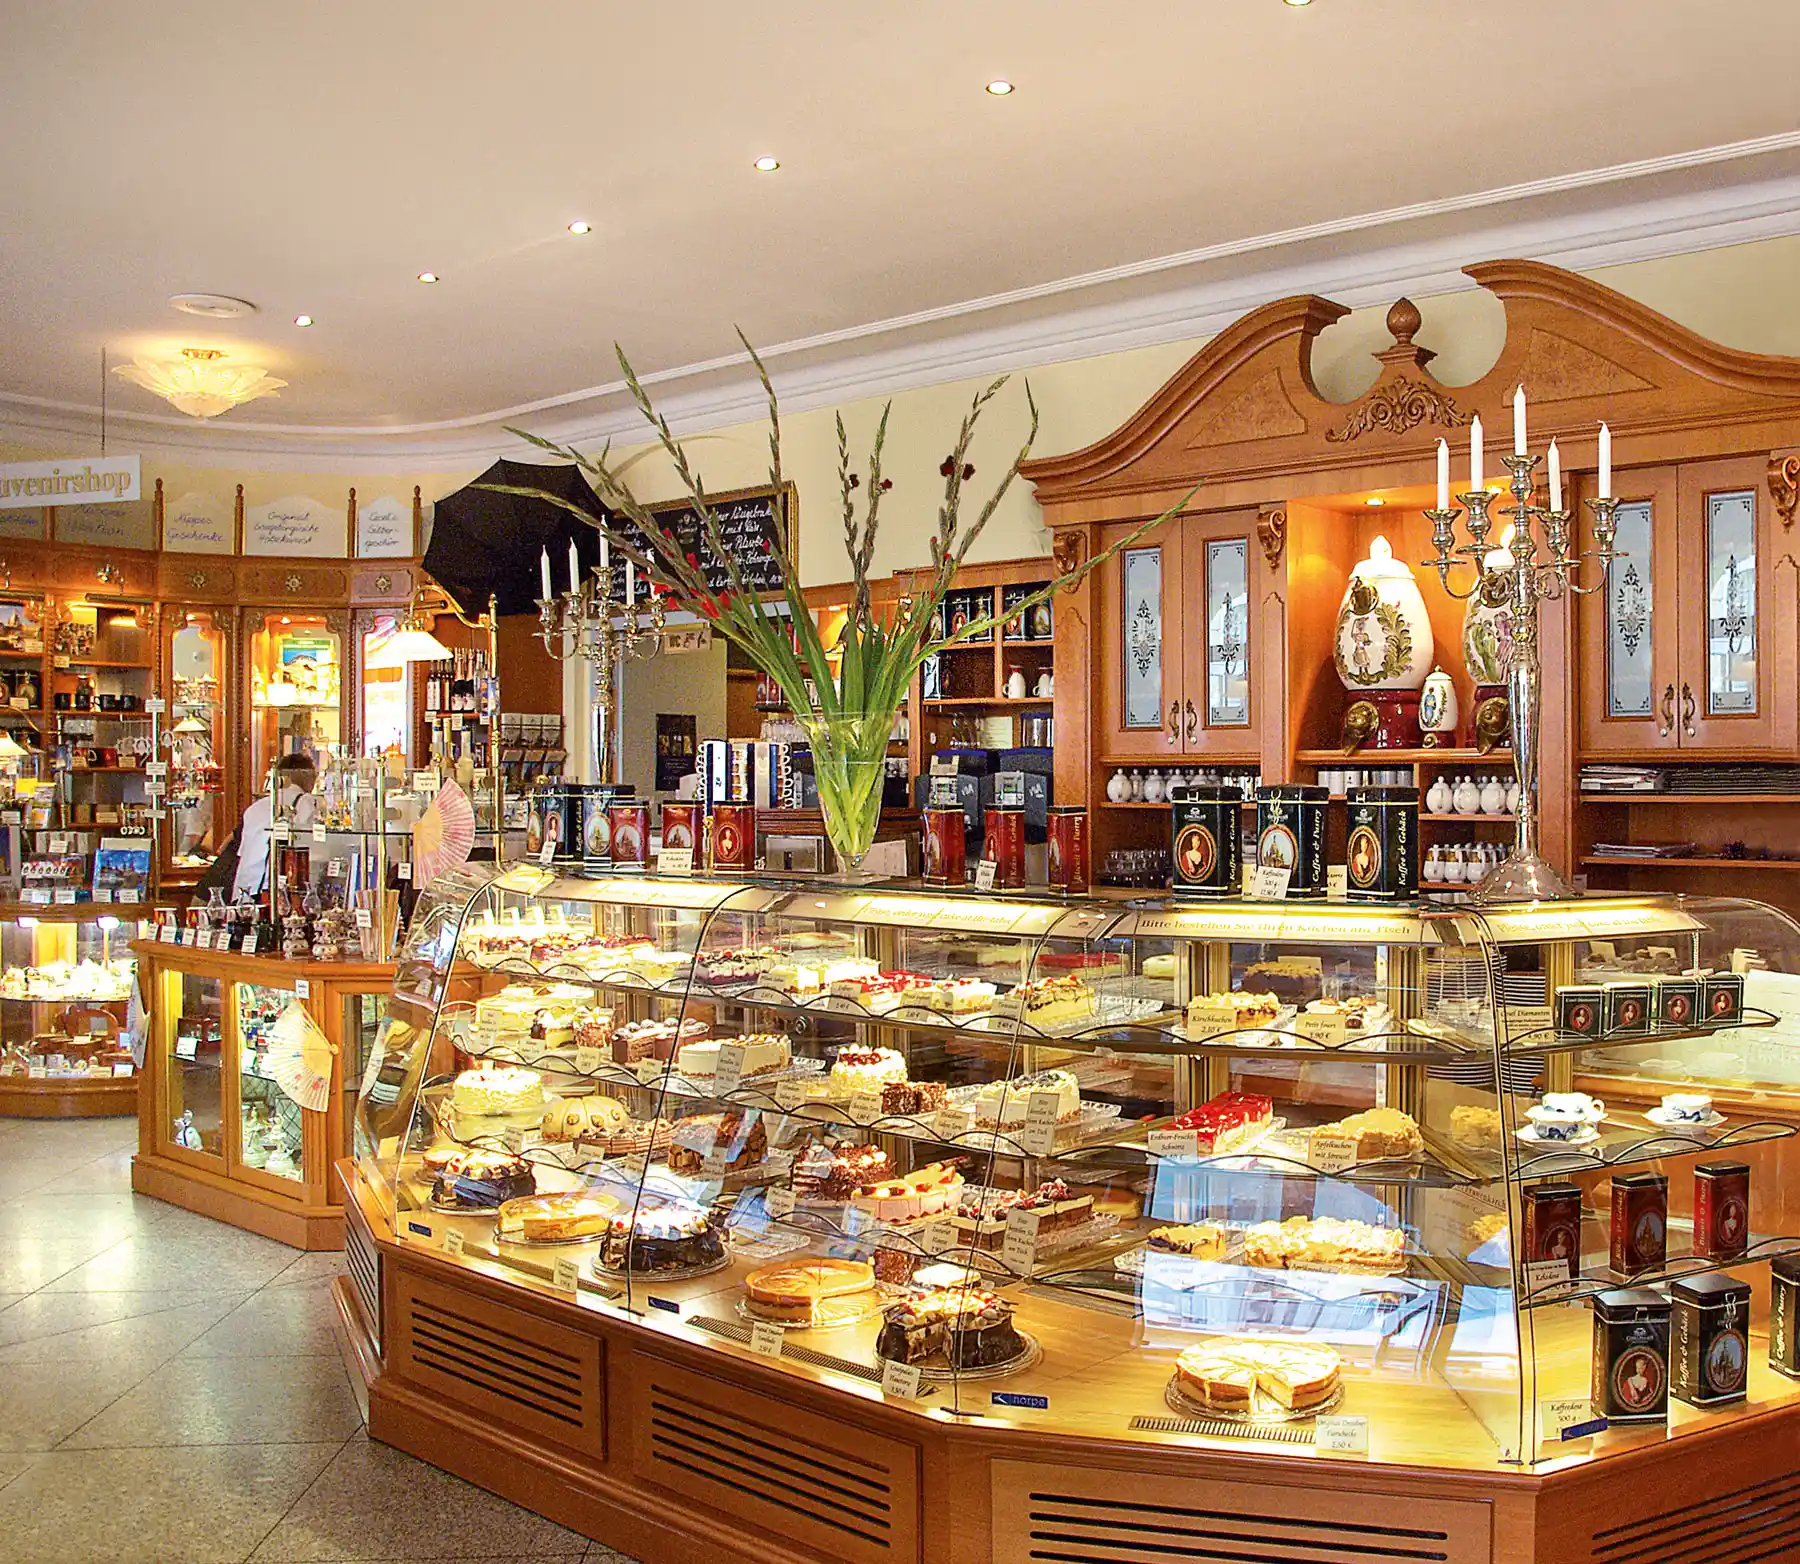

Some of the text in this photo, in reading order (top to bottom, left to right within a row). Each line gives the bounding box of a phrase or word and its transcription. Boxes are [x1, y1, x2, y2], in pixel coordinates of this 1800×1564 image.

[1397, 810, 1408, 886] Kaffee & Gebäck
[1229, 853, 1237, 880] Kaffee
[1312, 853, 1322, 882] Coffee
[1141, 920, 1172, 928] Bitte
[1174, 921, 1231, 930] bestellen
[1233, 923, 1253, 931] Sie
[1377, 926, 1411, 934] Tisch
[1192, 1015, 1232, 1024] Kirschkuchen
[1518, 1008, 1551, 1017] Diamanten
[1314, 1140, 1351, 1150] Apfelkuchen
[1315, 1151, 1351, 1161] mit Streusel
[1778, 1285, 1788, 1320] Pastry
[1680, 1309, 1690, 1344] Gebäck
[1777, 1331, 1786, 1360] Coffee
[1680, 1358, 1690, 1389] Kaffee
[1013, 1395, 1045, 1408] norpe
[1551, 1402, 1583, 1414] Kaffeedose
